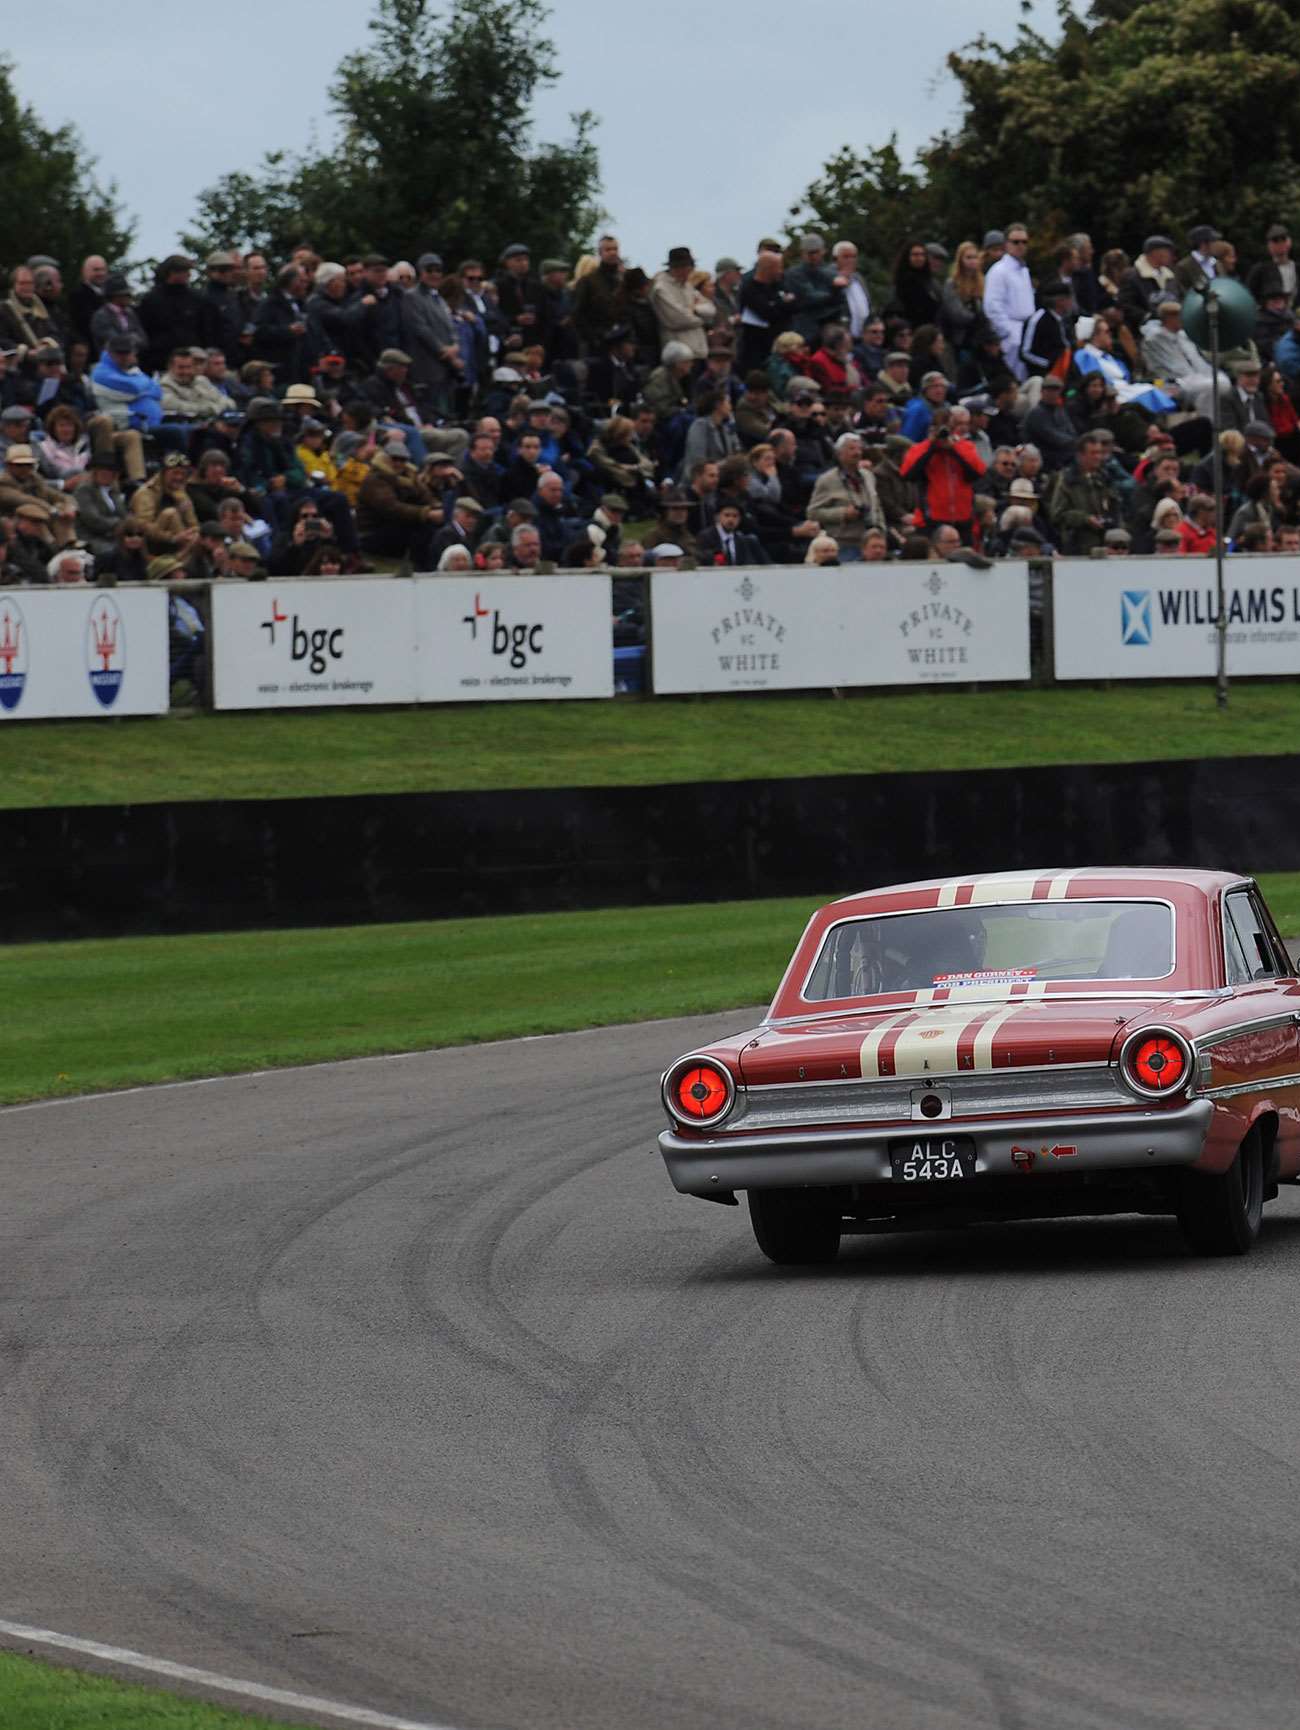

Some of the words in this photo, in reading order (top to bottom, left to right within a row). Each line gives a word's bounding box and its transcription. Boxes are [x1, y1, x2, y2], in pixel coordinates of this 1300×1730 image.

[899, 602, 974, 638] PRIVATE
[1158, 587, 1285, 625] WILLAMS
[491, 609, 543, 669] bgc
[711, 608, 786, 644] PRIVATE
[291, 614, 344, 675] bgc
[718, 653, 780, 672] WHITE
[907, 646, 968, 665] WHITE
[911, 1141, 957, 1161] ALC
[902, 1160, 965, 1182] 543A
